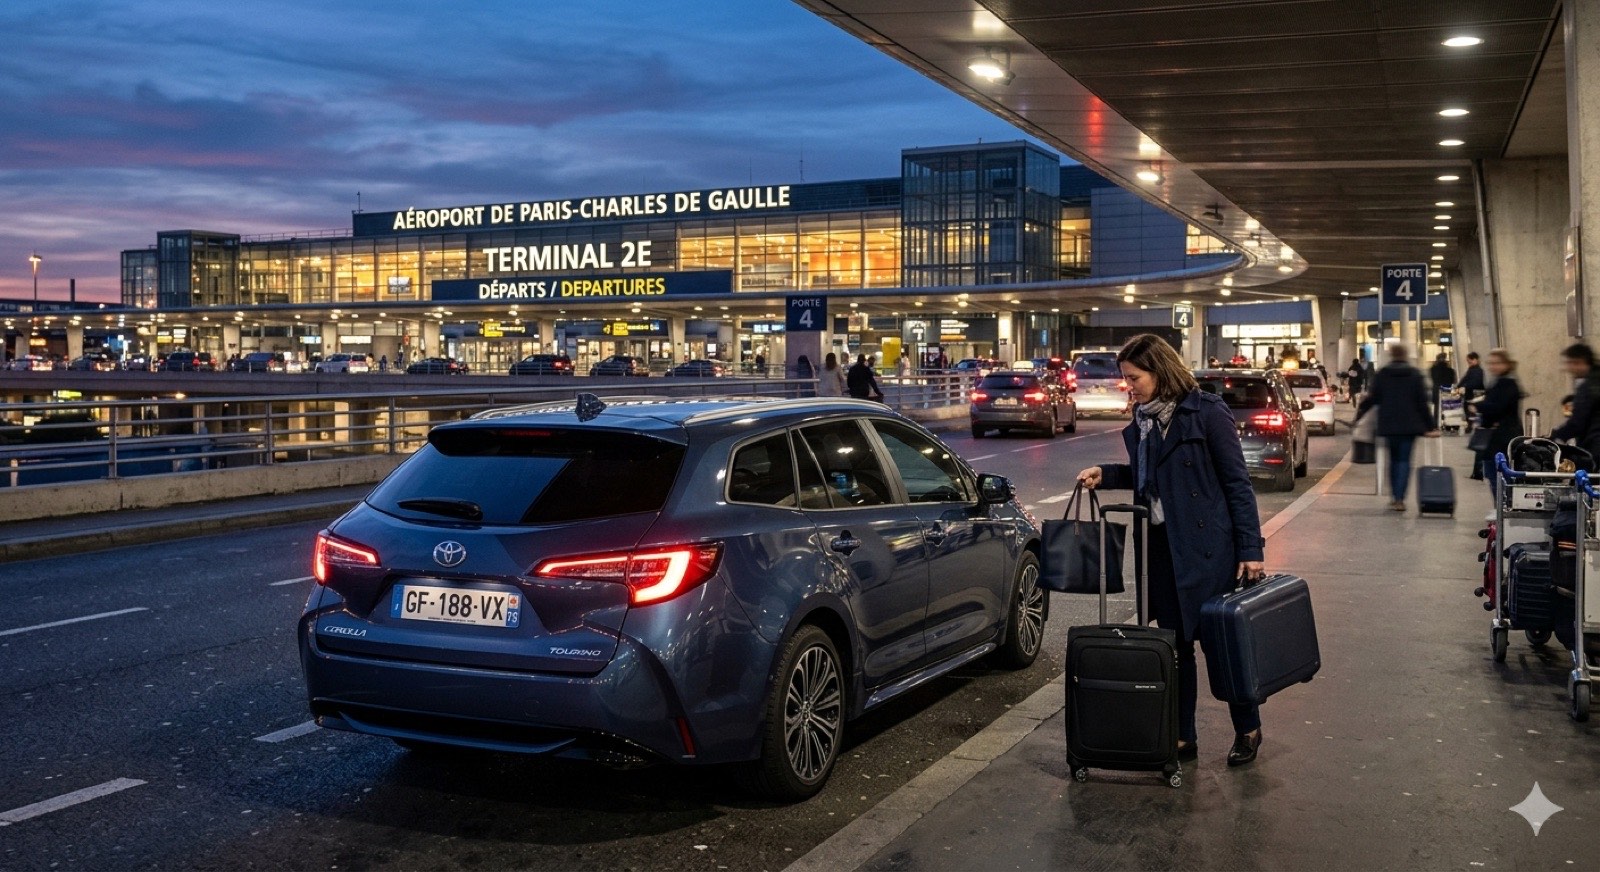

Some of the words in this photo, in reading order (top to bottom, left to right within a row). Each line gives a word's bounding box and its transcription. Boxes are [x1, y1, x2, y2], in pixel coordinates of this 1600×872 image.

[393, 206, 484, 230] AÉROPORT
[491, 204, 514, 224] DE
[520, 194, 667, 222] PARIS-CHARLES
[674, 192, 700, 213] DE
[708, 185, 790, 211] GAULLE
[482, 242, 614, 273] TERMINAL
[621, 240, 652, 268] 2E
[1386, 268, 1423, 279] PORTE
[478, 279, 547, 299] DÉPARTS
[550, 281, 557, 298] /
[561, 278, 666, 298] DEPARTURES
[1395, 279, 1414, 301] 4
[791, 299, 820, 308] PORTE
[799, 309, 814, 328] 4
[1179, 312, 1188, 327] 4
[405, 590, 506, 621] GF-188-VX
